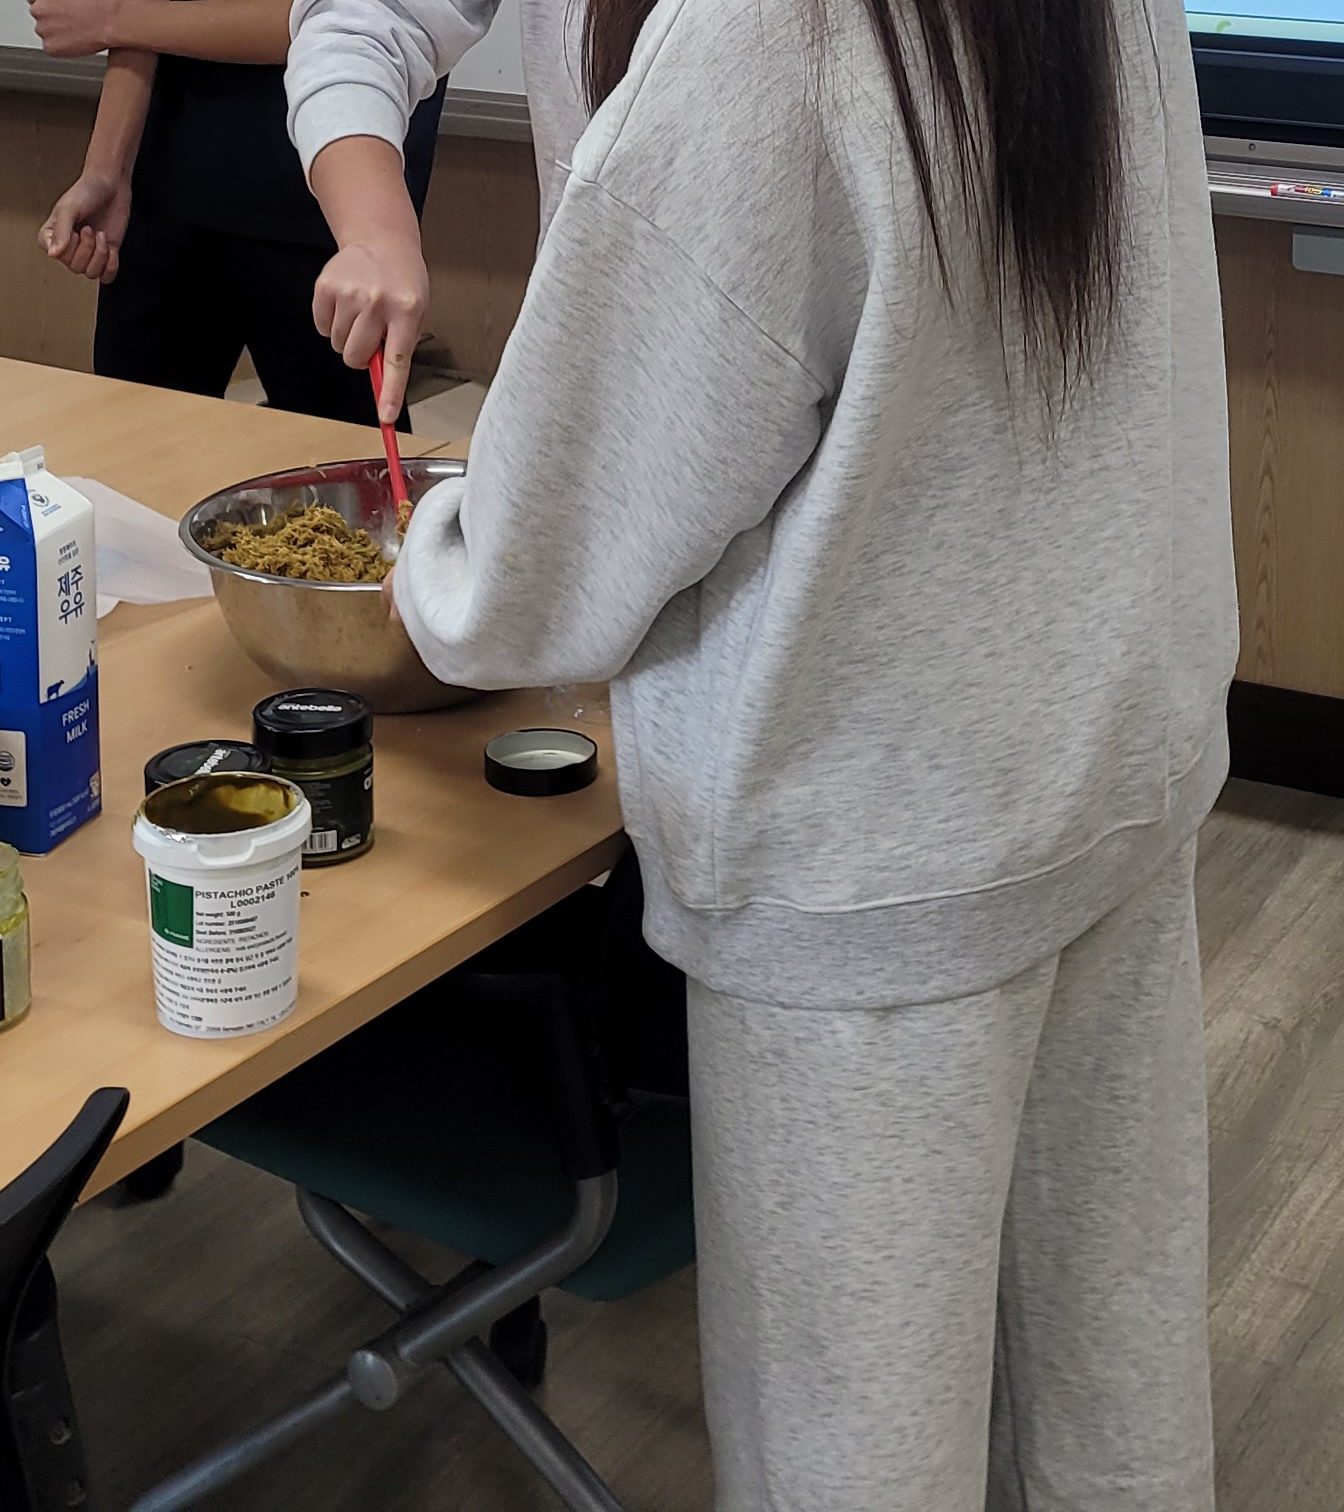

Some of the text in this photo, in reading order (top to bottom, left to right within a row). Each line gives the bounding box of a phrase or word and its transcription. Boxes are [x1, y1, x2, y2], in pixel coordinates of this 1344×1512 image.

[57, 564, 84, 597] 제주
[58, 591, 85, 625] 우유
[62, 698, 90, 727] FRESH
[66, 720, 88, 744] MILK
[195, 887, 254, 900] PISTACHIO
[256, 875, 285, 894] PASTE
